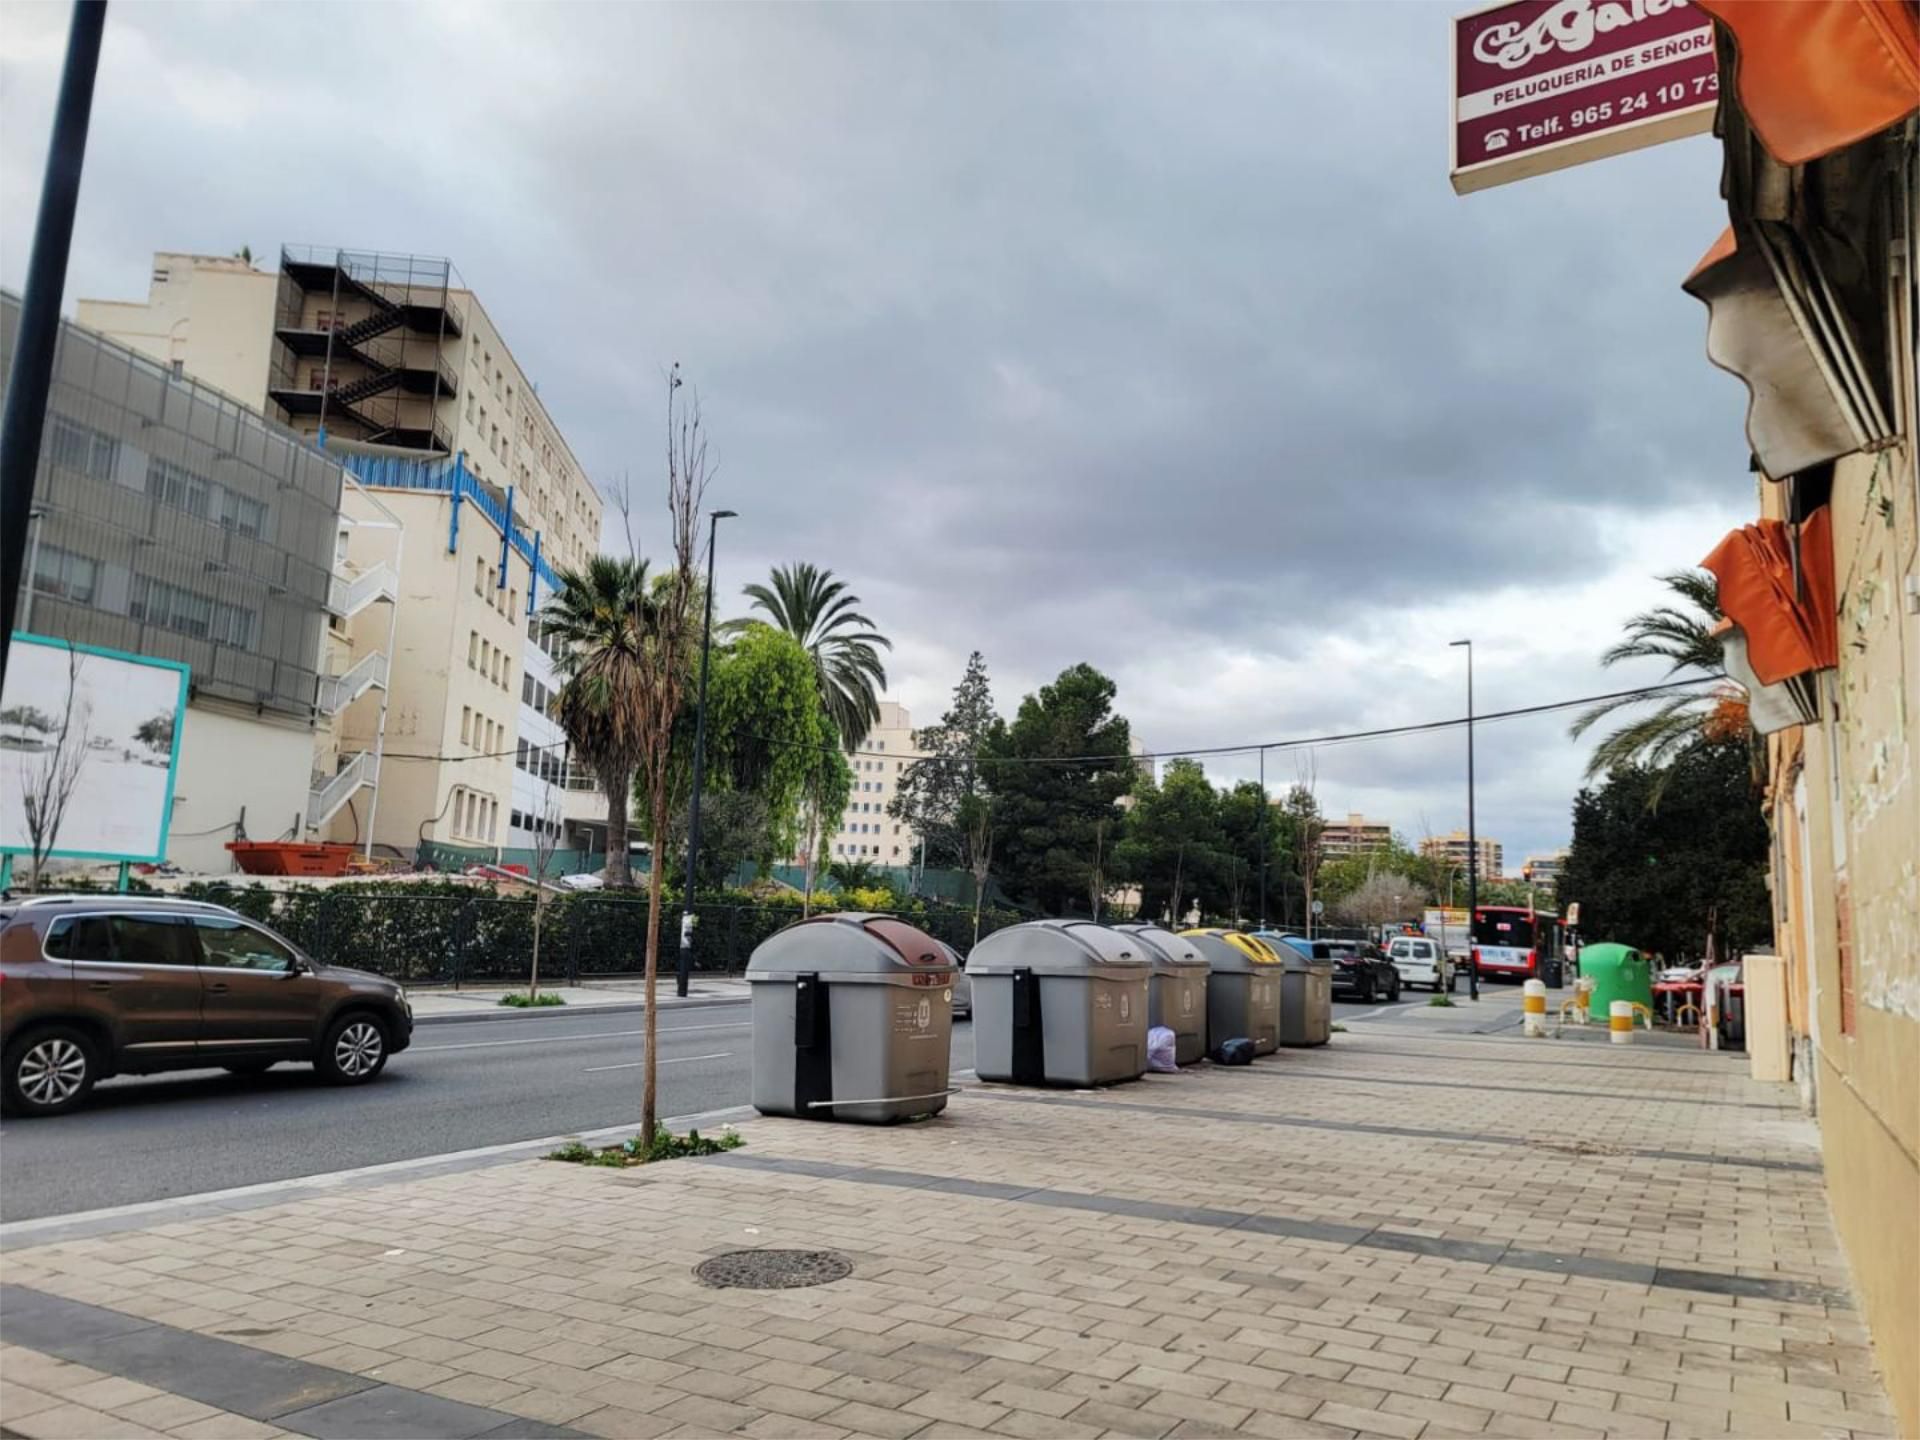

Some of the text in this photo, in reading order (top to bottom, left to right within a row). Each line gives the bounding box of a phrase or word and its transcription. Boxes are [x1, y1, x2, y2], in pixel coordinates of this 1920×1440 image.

[1494, 64, 1606, 106] PELUQUERÍA
[1611, 54, 1635, 72] DE
[1517, 72, 1719, 141] Telf. 965 24 10 73
